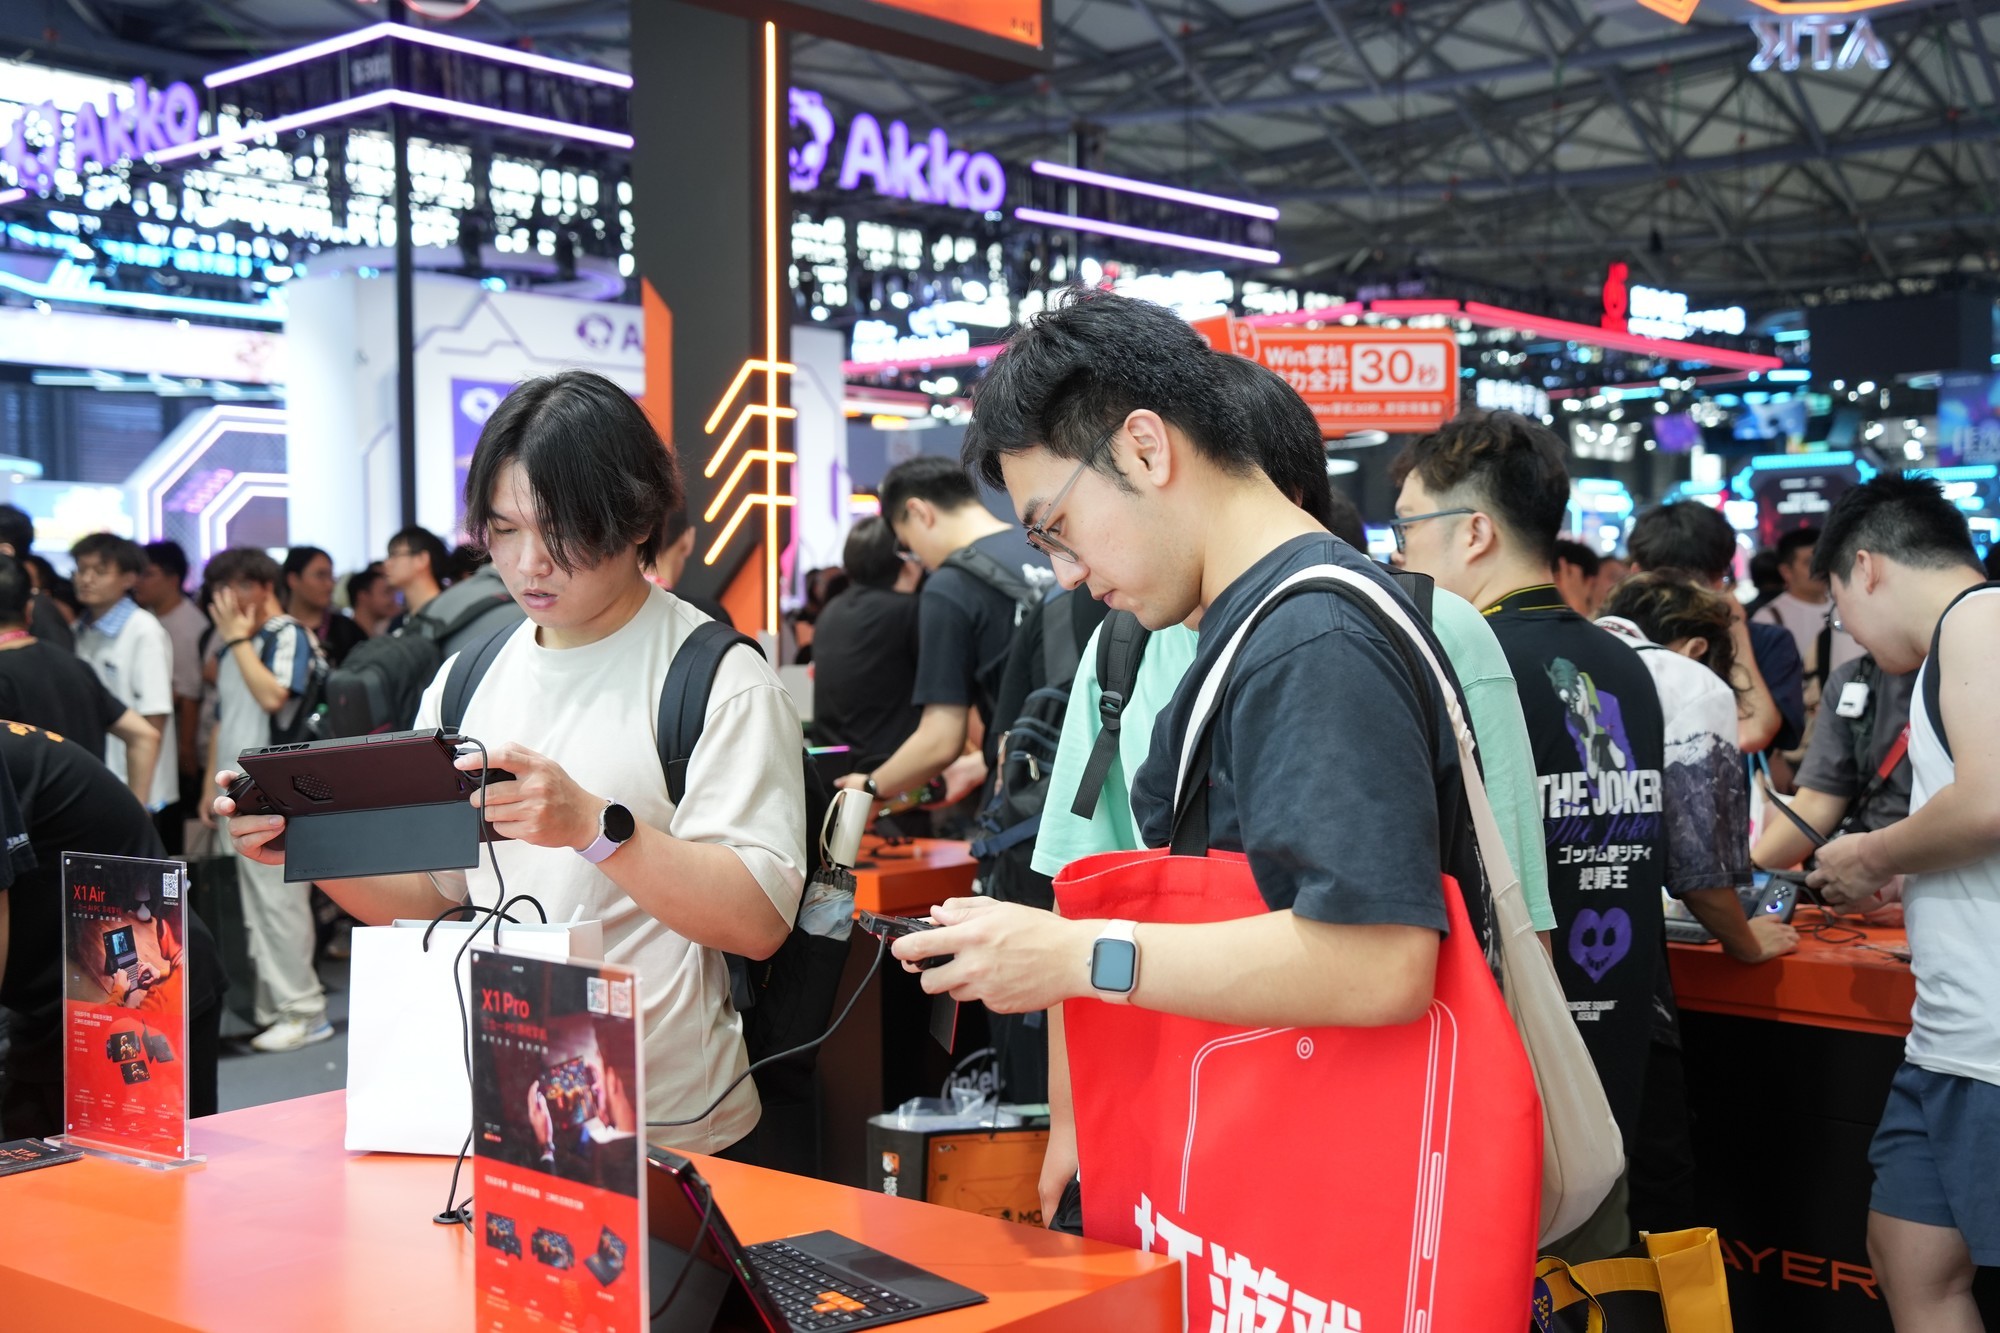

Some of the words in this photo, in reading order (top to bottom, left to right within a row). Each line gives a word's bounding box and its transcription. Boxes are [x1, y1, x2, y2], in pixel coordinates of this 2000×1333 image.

[75, 76, 200, 174] Akko
[839, 112, 1006, 213] Akko
[1264, 344, 1348, 368] Win掌机
[1360, 349, 1439, 387] 30秒
[1538, 772, 1589, 819] THE
[1592, 770, 1663, 815] JOKER
[74, 885, 87, 901] X1
[89, 887, 106, 902] Air
[1579, 866, 1629, 890] 犯罪王
[482, 989, 500, 1013] X1
[503, 993, 530, 1019] Pro
